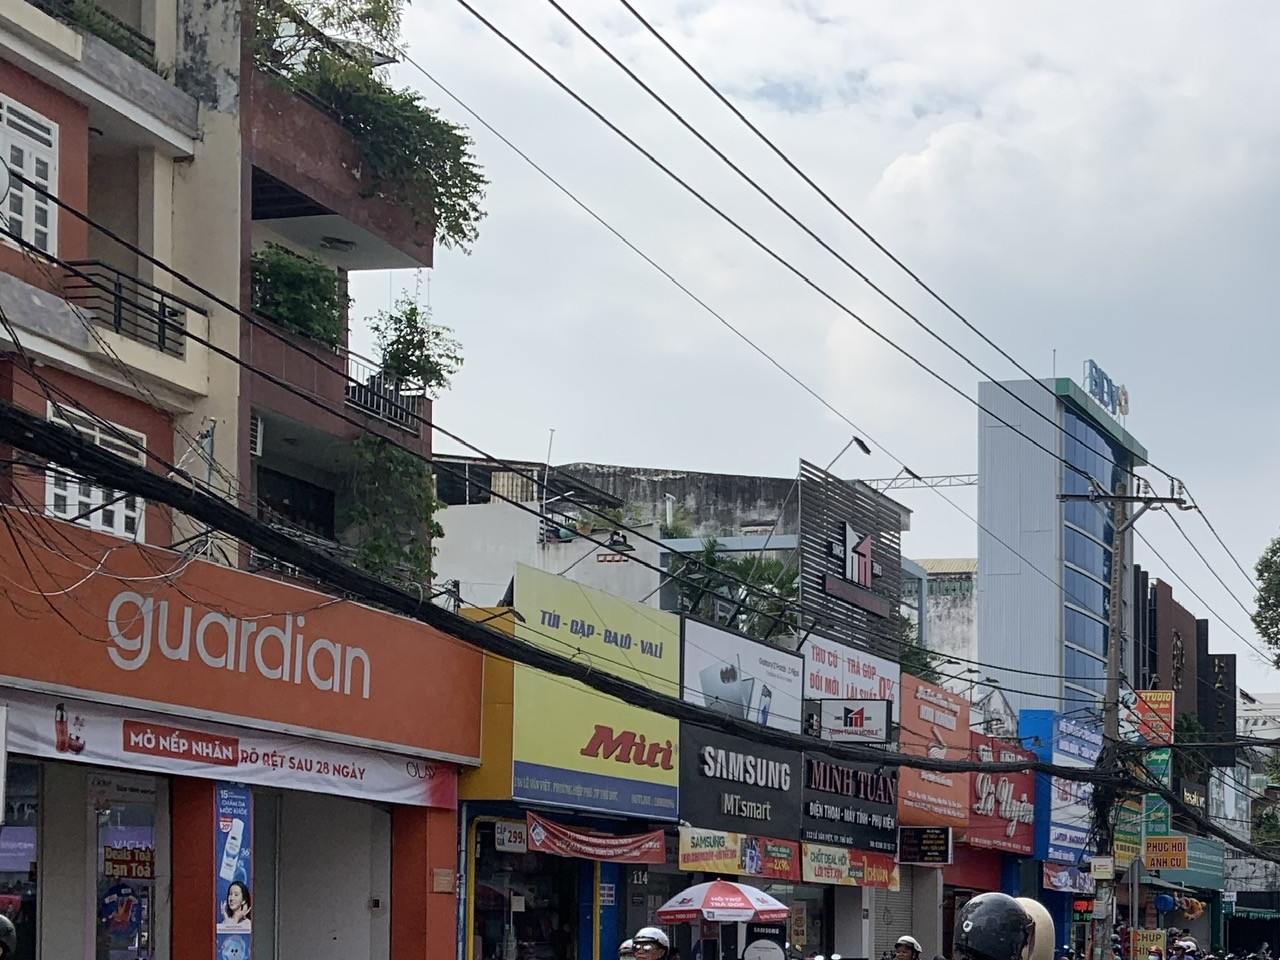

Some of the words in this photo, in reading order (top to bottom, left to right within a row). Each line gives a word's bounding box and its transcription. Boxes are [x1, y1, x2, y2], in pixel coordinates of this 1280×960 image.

[106, 590, 371, 699] guardian
[1140, 692, 1171, 702] STUDIO
[130, 730, 156, 749] MỜ
[159, 729, 188, 754] NẾP
[262, 750, 286, 772] RỆT
[288, 756, 314, 773] SAU
[316, 760, 330, 776] 28
[332, 762, 366, 781] NGÀY
[703, 745, 791, 793] SAMSUNG
[811, 759, 854, 796] MINH
[858, 764, 897, 805] TUẤN
